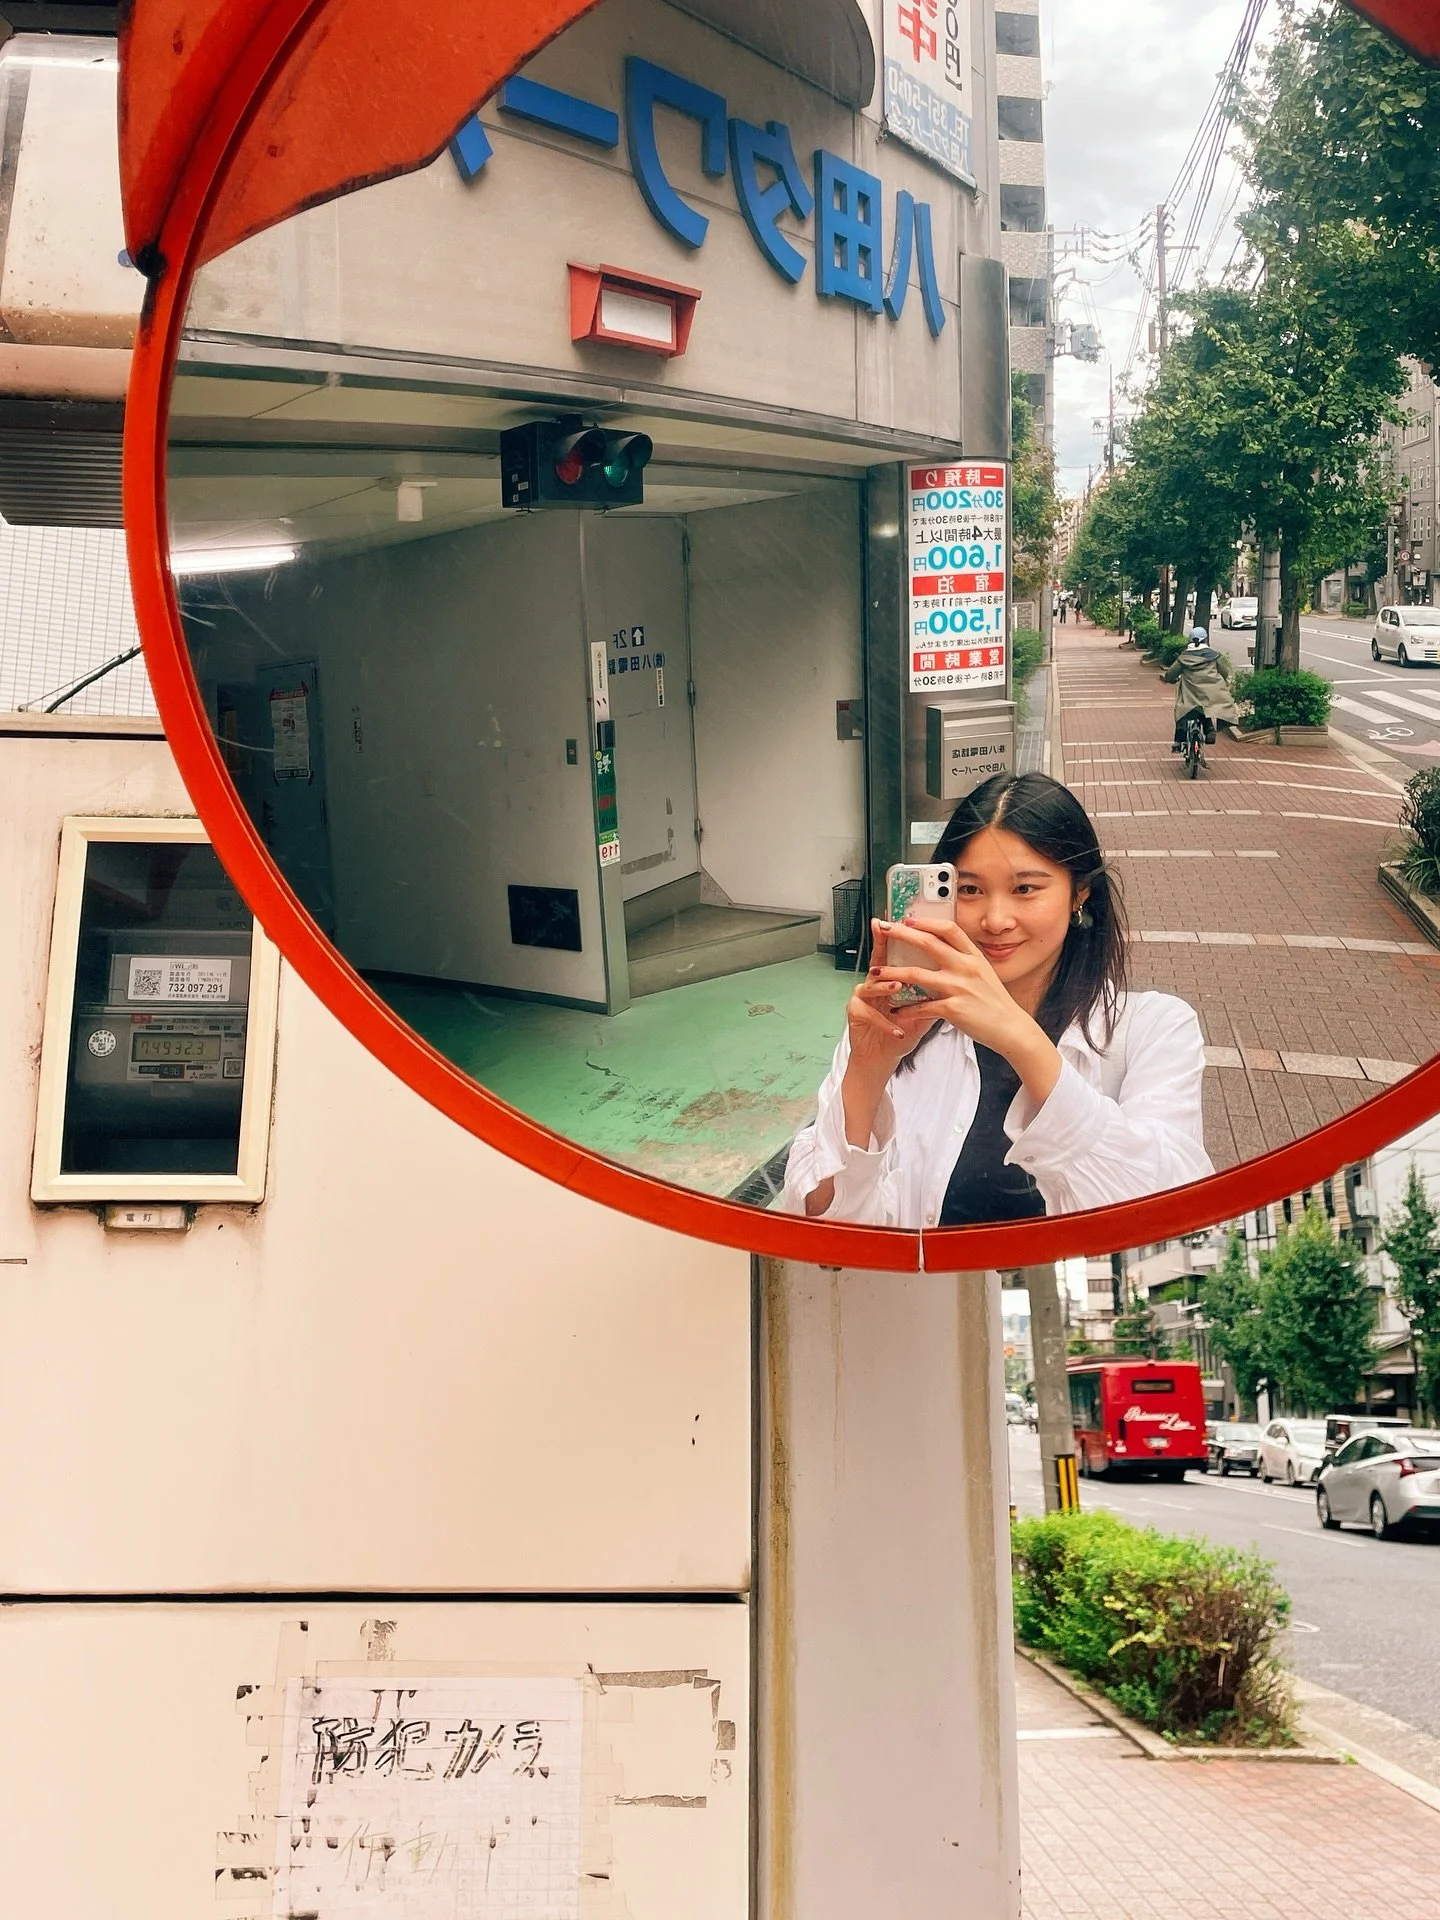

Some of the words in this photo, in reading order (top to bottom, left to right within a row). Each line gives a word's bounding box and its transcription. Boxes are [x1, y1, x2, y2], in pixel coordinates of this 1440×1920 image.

[168, 983, 185, 992] 732
[187, 983, 204, 993] 097
[207, 984, 223, 993] 291
